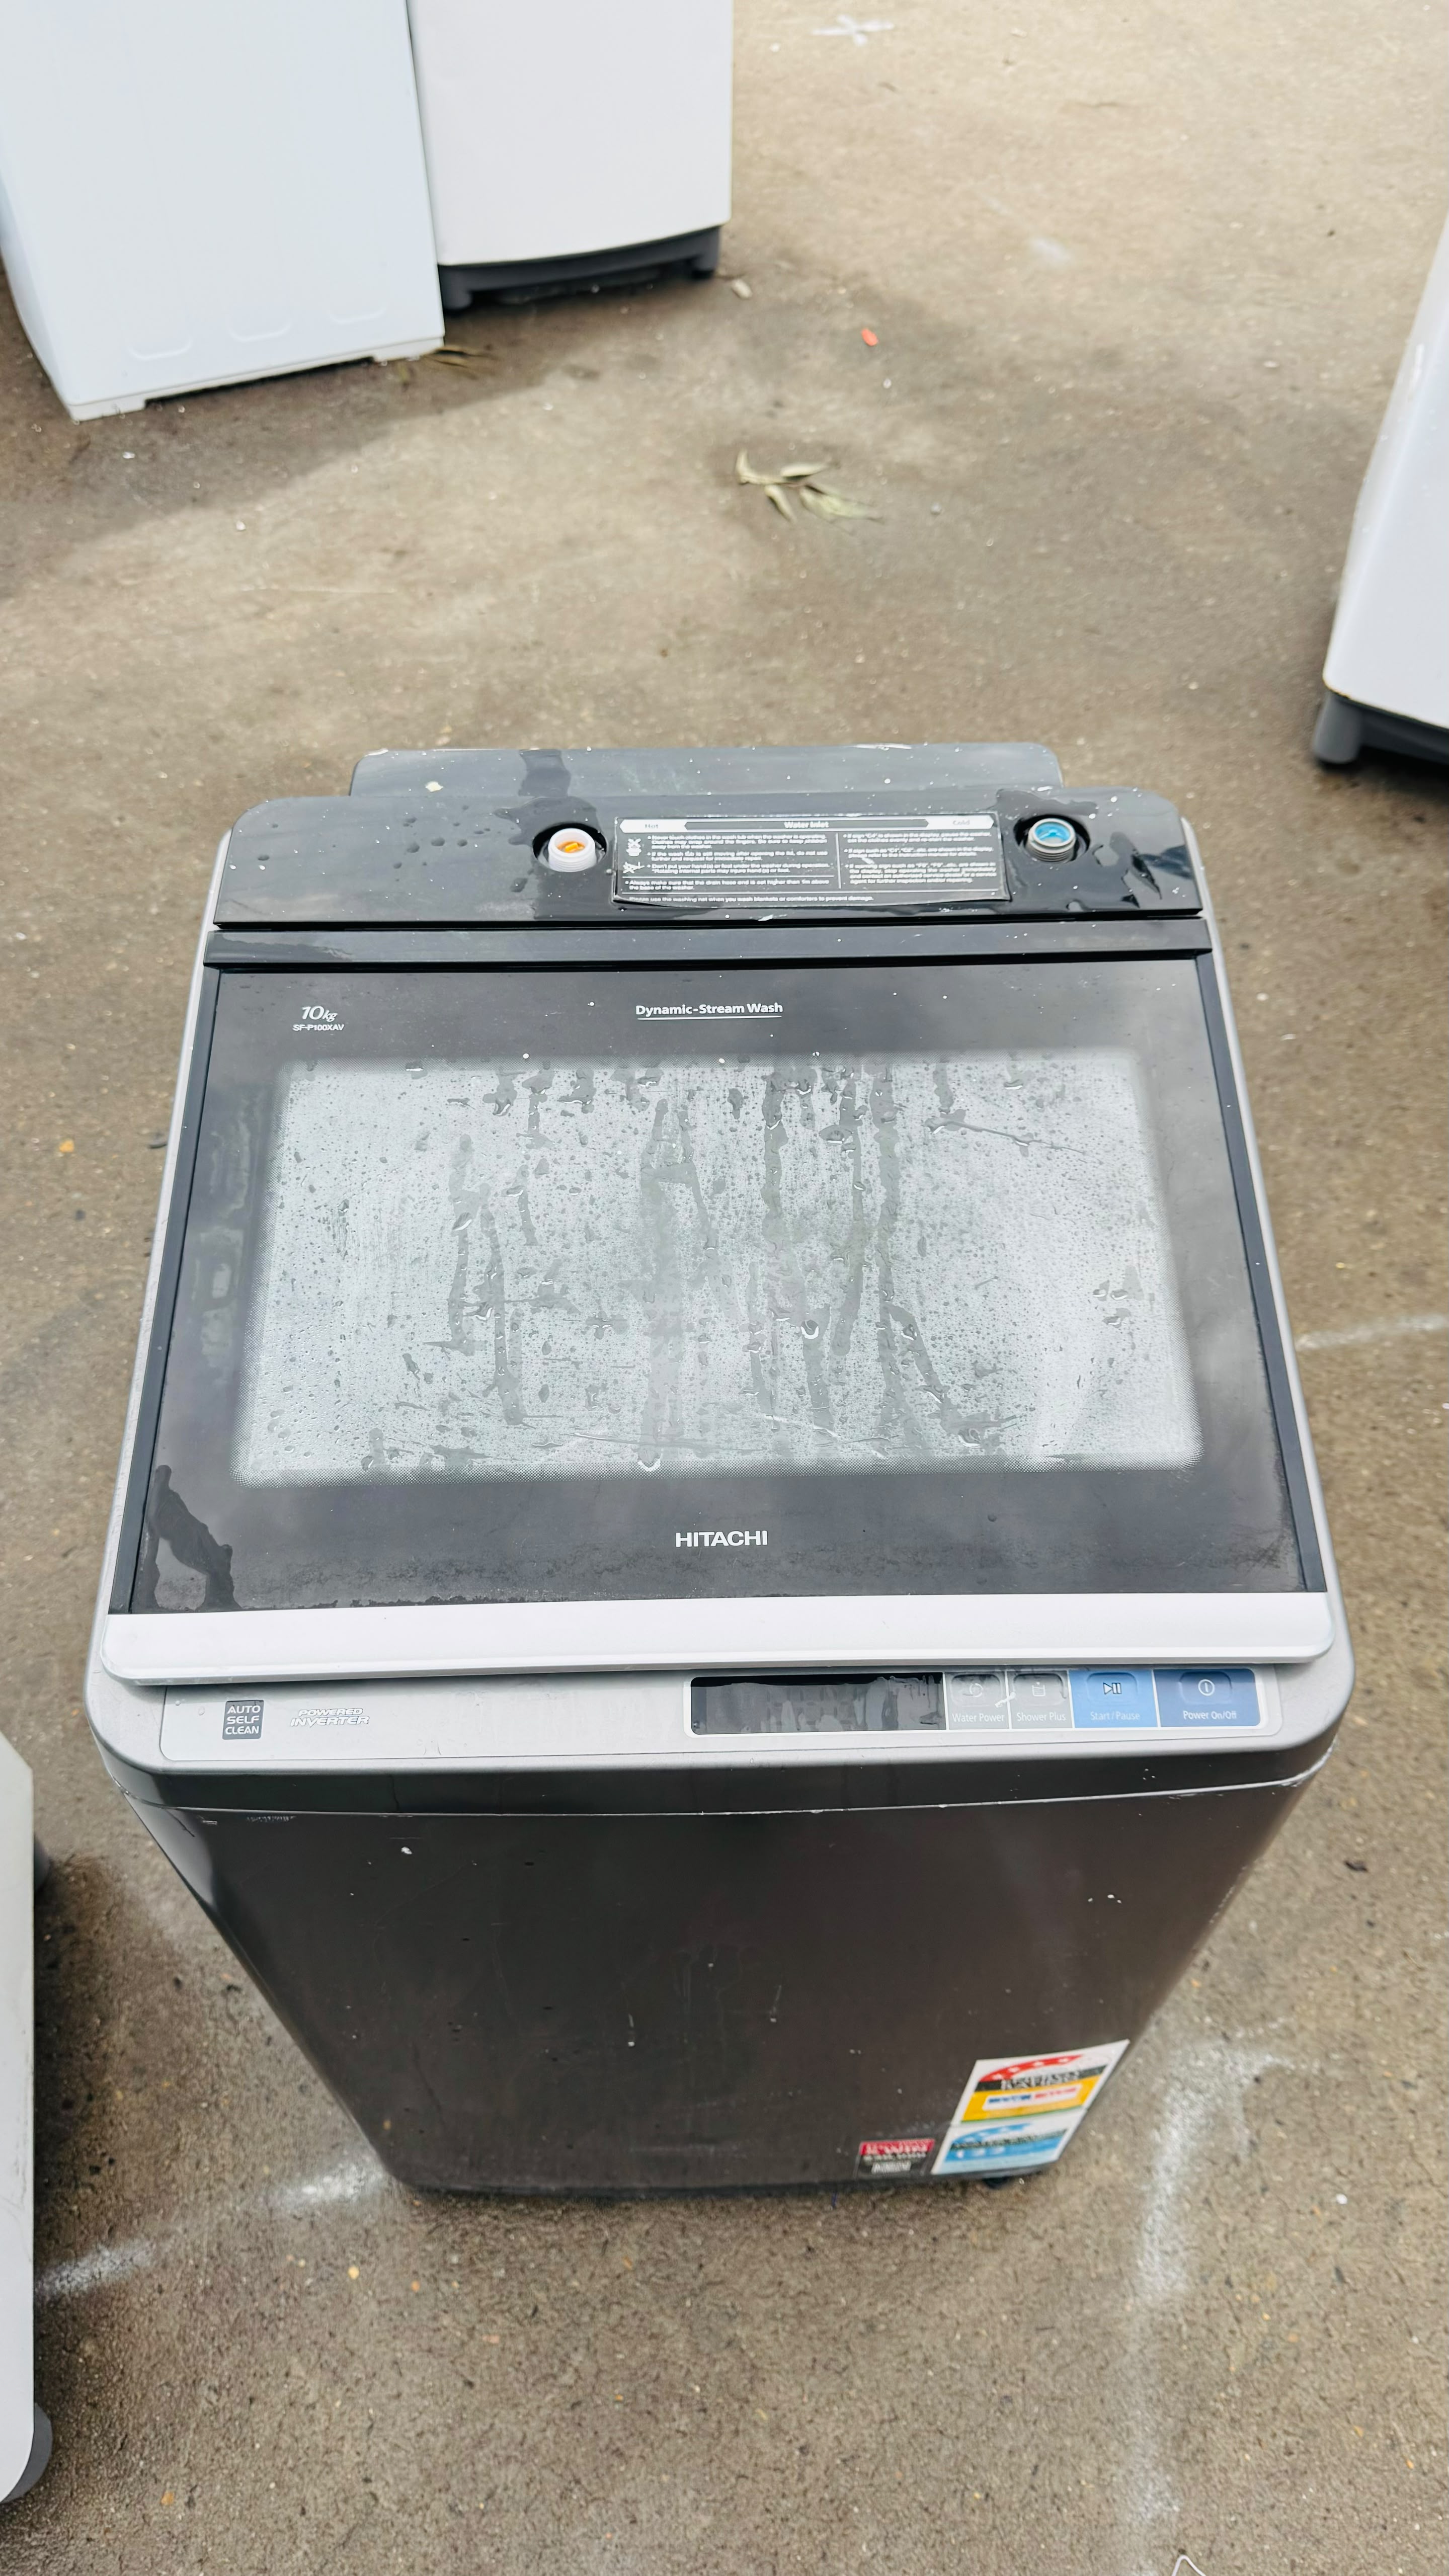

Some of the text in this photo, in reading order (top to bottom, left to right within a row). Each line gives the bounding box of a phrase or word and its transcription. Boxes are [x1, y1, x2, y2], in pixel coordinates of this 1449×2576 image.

[302, 1006, 338, 1022] 10kg
[636, 1002, 783, 1017] Dynamic-Stream Wash
[676, 1531, 768, 1548] HITACHI
[227, 1705, 261, 1714] AUTO
[298, 1708, 363, 1717] POWERED
[227, 1715, 259, 1724] SELF
[952, 1713, 1004, 1722] Water Power
[1017, 1712, 1066, 1721] Shower Plus
[1090, 1712, 1110, 1721] Start
[1115, 1711, 1140, 1720] Pause
[1183, 1711, 1237, 1720] Power On/Off
[290, 1716, 370, 1727] INVERTER
[225, 1726, 259, 1735] CLEAN
